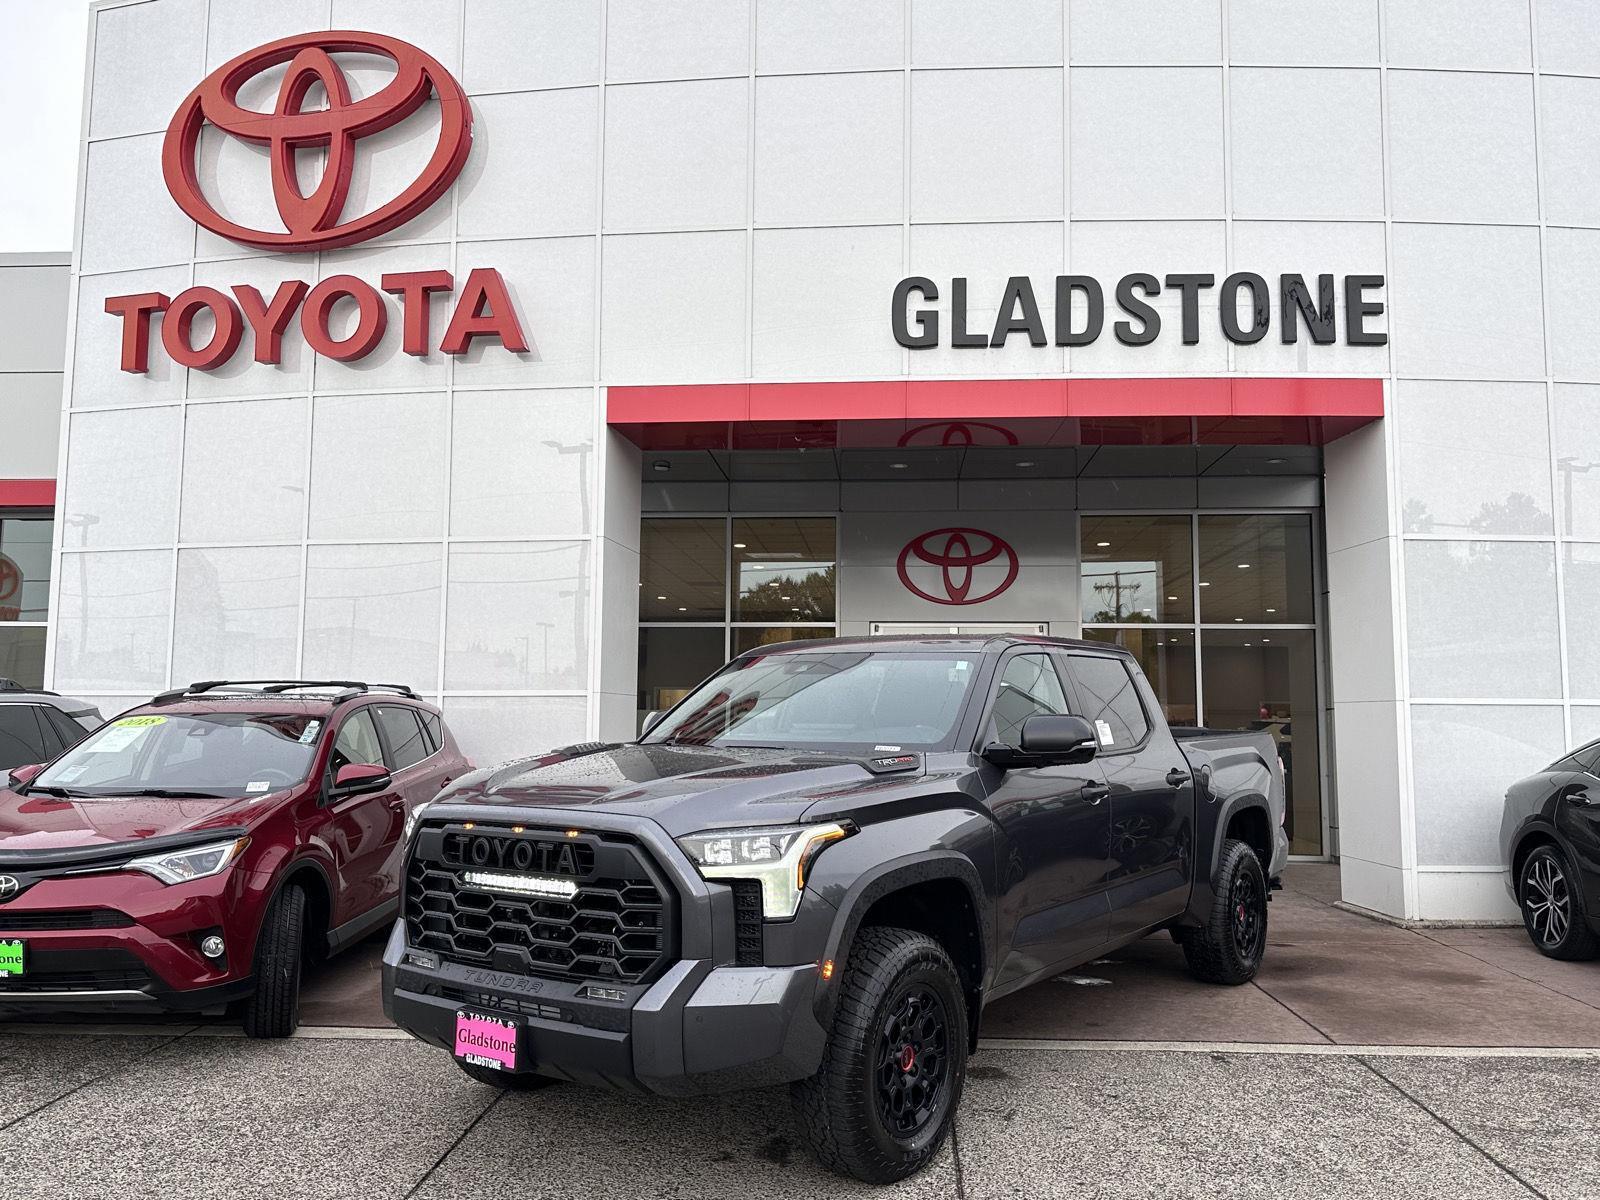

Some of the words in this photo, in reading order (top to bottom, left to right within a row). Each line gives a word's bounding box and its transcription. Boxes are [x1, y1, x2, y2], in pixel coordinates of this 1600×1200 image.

[105, 268, 529, 374] TOYOTA
[891, 272, 1388, 349] GLADSTONE
[455, 834, 578, 875] TOYOTA
[464, 969, 544, 994] TUNDRA
[469, 1012, 503, 1026] TOYOTA
[458, 1028, 516, 1054] Gladstone
[466, 1053, 502, 1071] GLADSTONE
